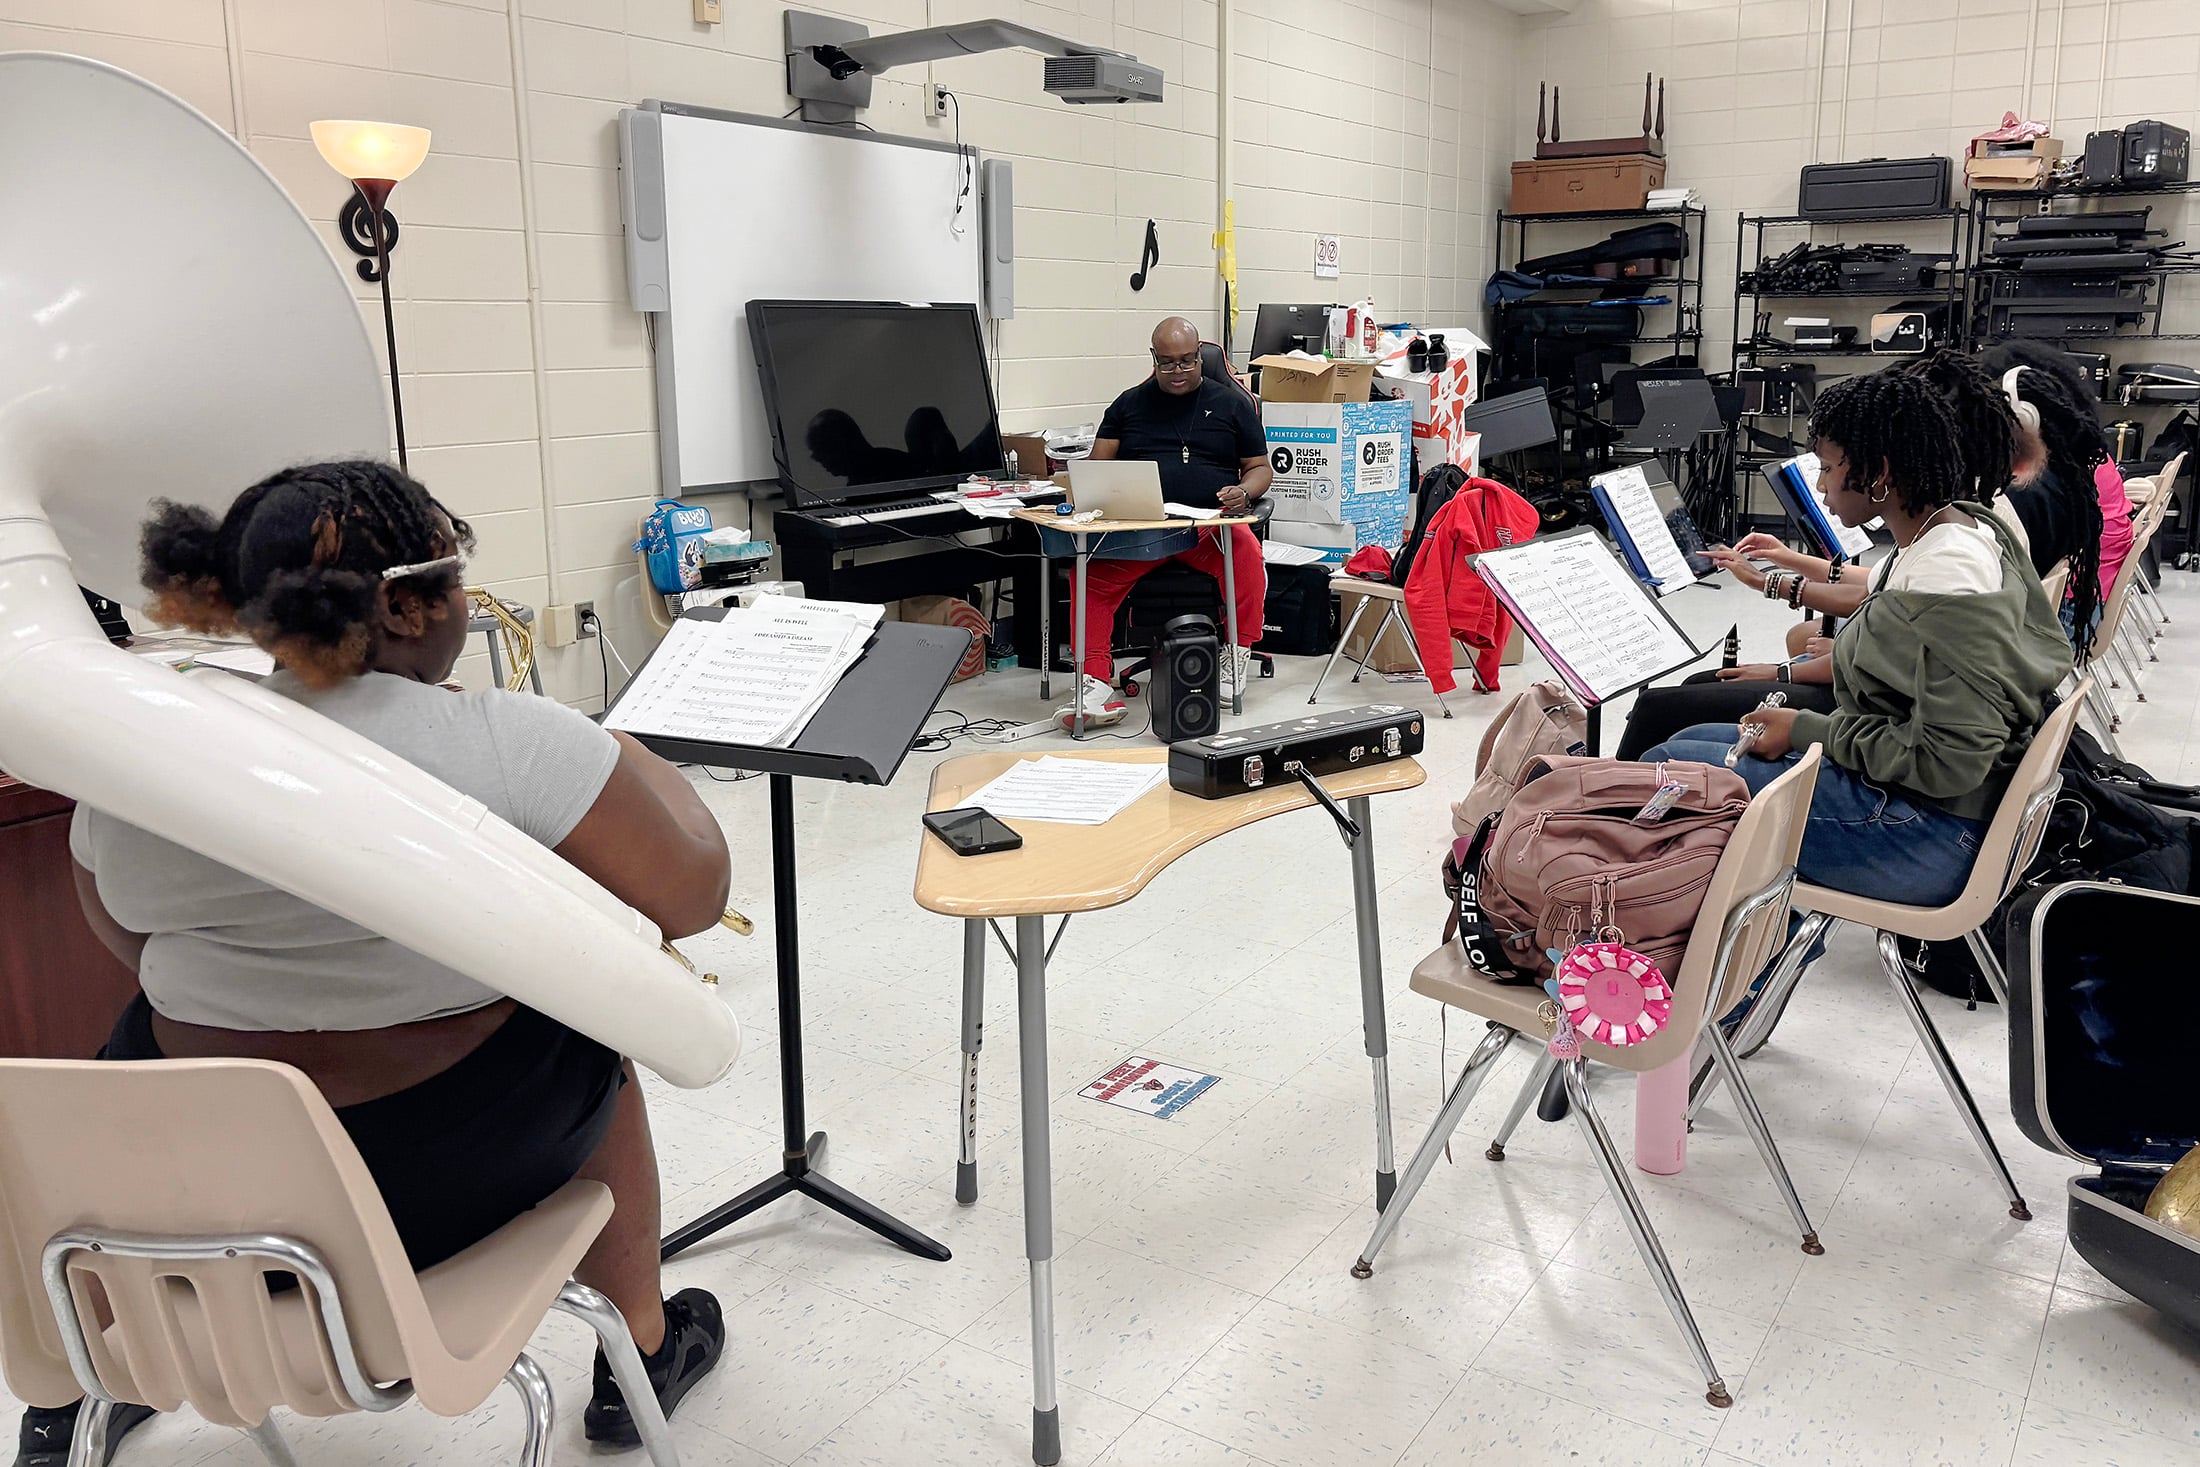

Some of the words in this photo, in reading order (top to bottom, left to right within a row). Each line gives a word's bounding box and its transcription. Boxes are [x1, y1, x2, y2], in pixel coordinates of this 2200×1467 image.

[1296, 448, 1321, 457] RUSH
[1377, 448, 1394, 456] ORDER
[1296, 458, 1328, 466] ORDER
[1296, 466, 1318, 475] TEES
[1461, 872, 1478, 923] SELF
